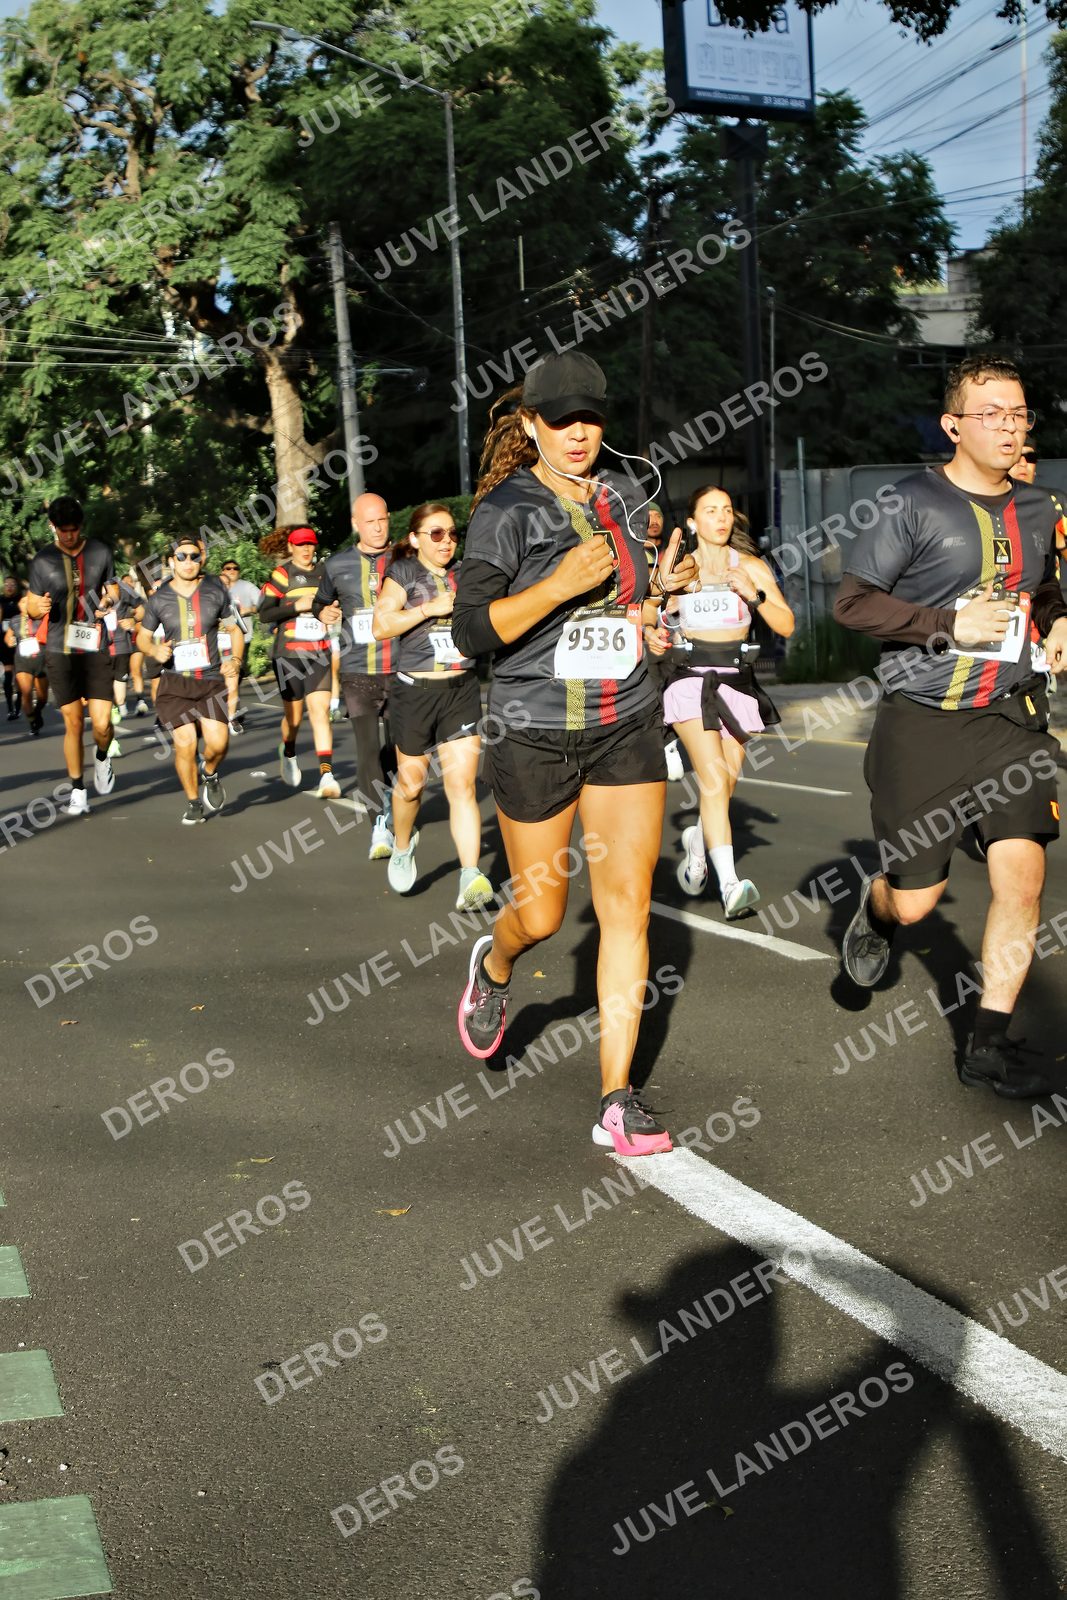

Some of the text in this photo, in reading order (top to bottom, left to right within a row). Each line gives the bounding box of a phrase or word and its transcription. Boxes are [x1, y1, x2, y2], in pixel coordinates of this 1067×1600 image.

[693, 598, 729, 613] 8895
[75, 629, 92, 640] 508
[568, 627, 626, 651] 9536
